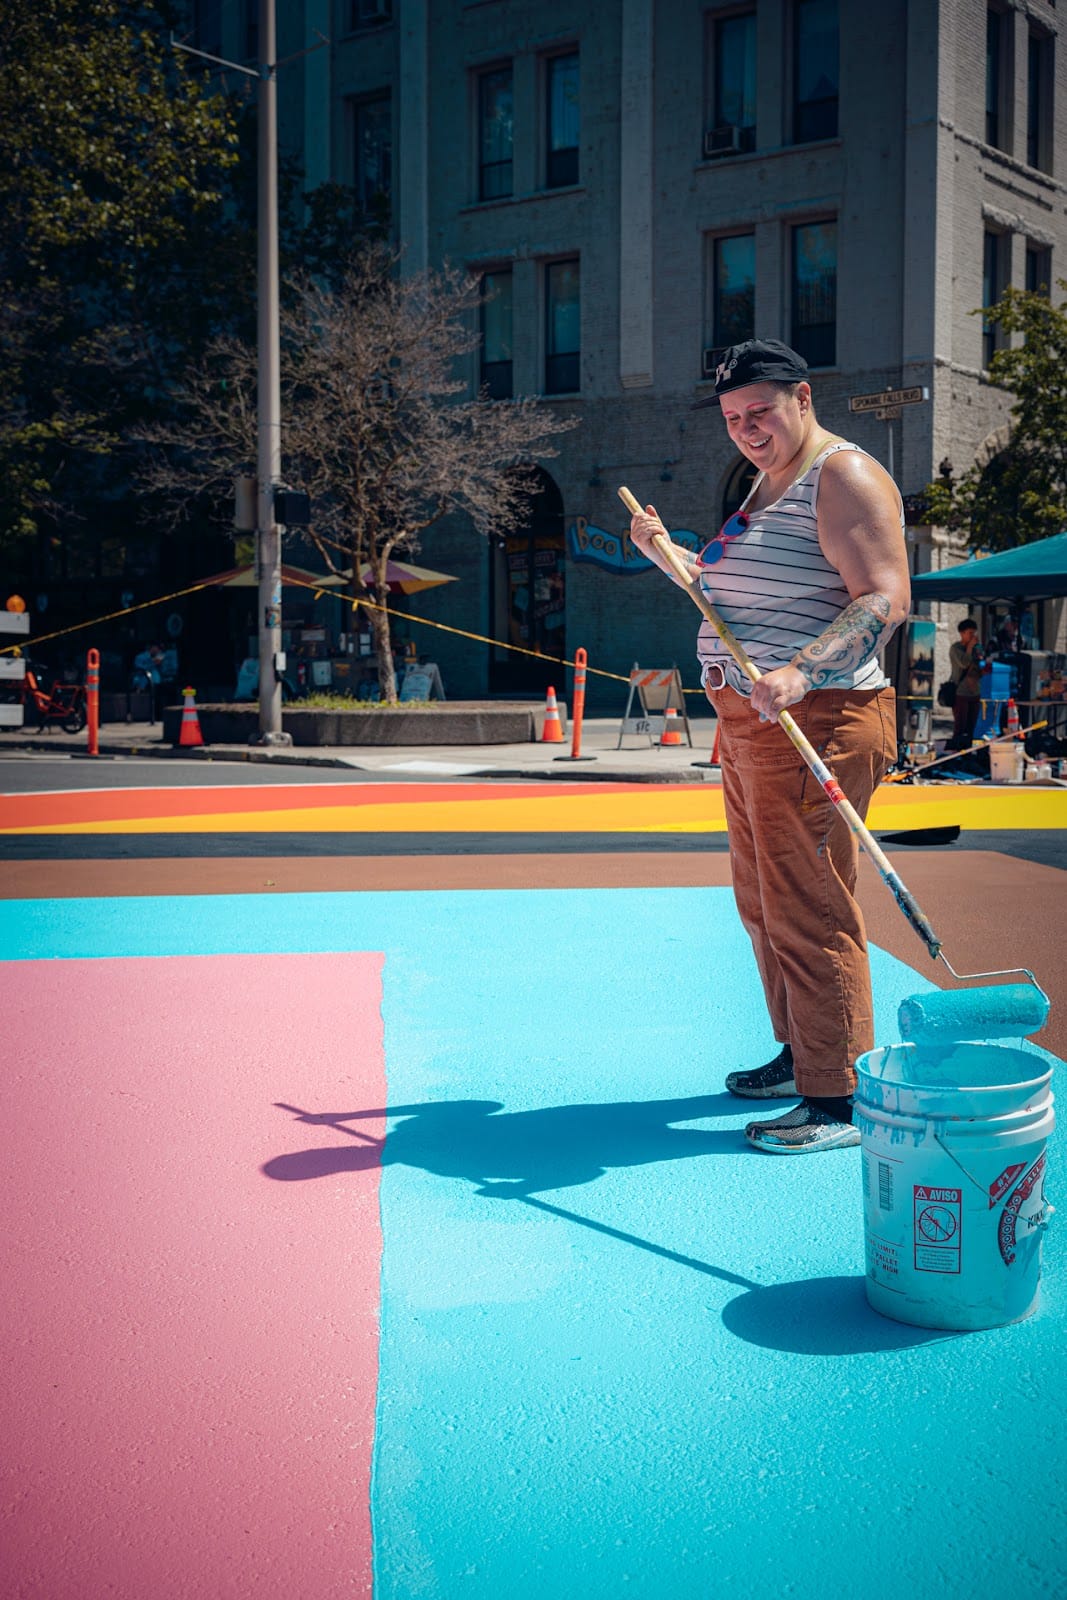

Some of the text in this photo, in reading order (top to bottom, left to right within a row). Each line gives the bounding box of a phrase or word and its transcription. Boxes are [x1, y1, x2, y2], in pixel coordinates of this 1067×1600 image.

[854, 389, 920, 408] SPOKANE FALLS BLVD
[929, 1189, 958, 1202] AVISO
[875, 1251, 899, 1266] PALLET
[882, 1263, 899, 1275] HIGH
